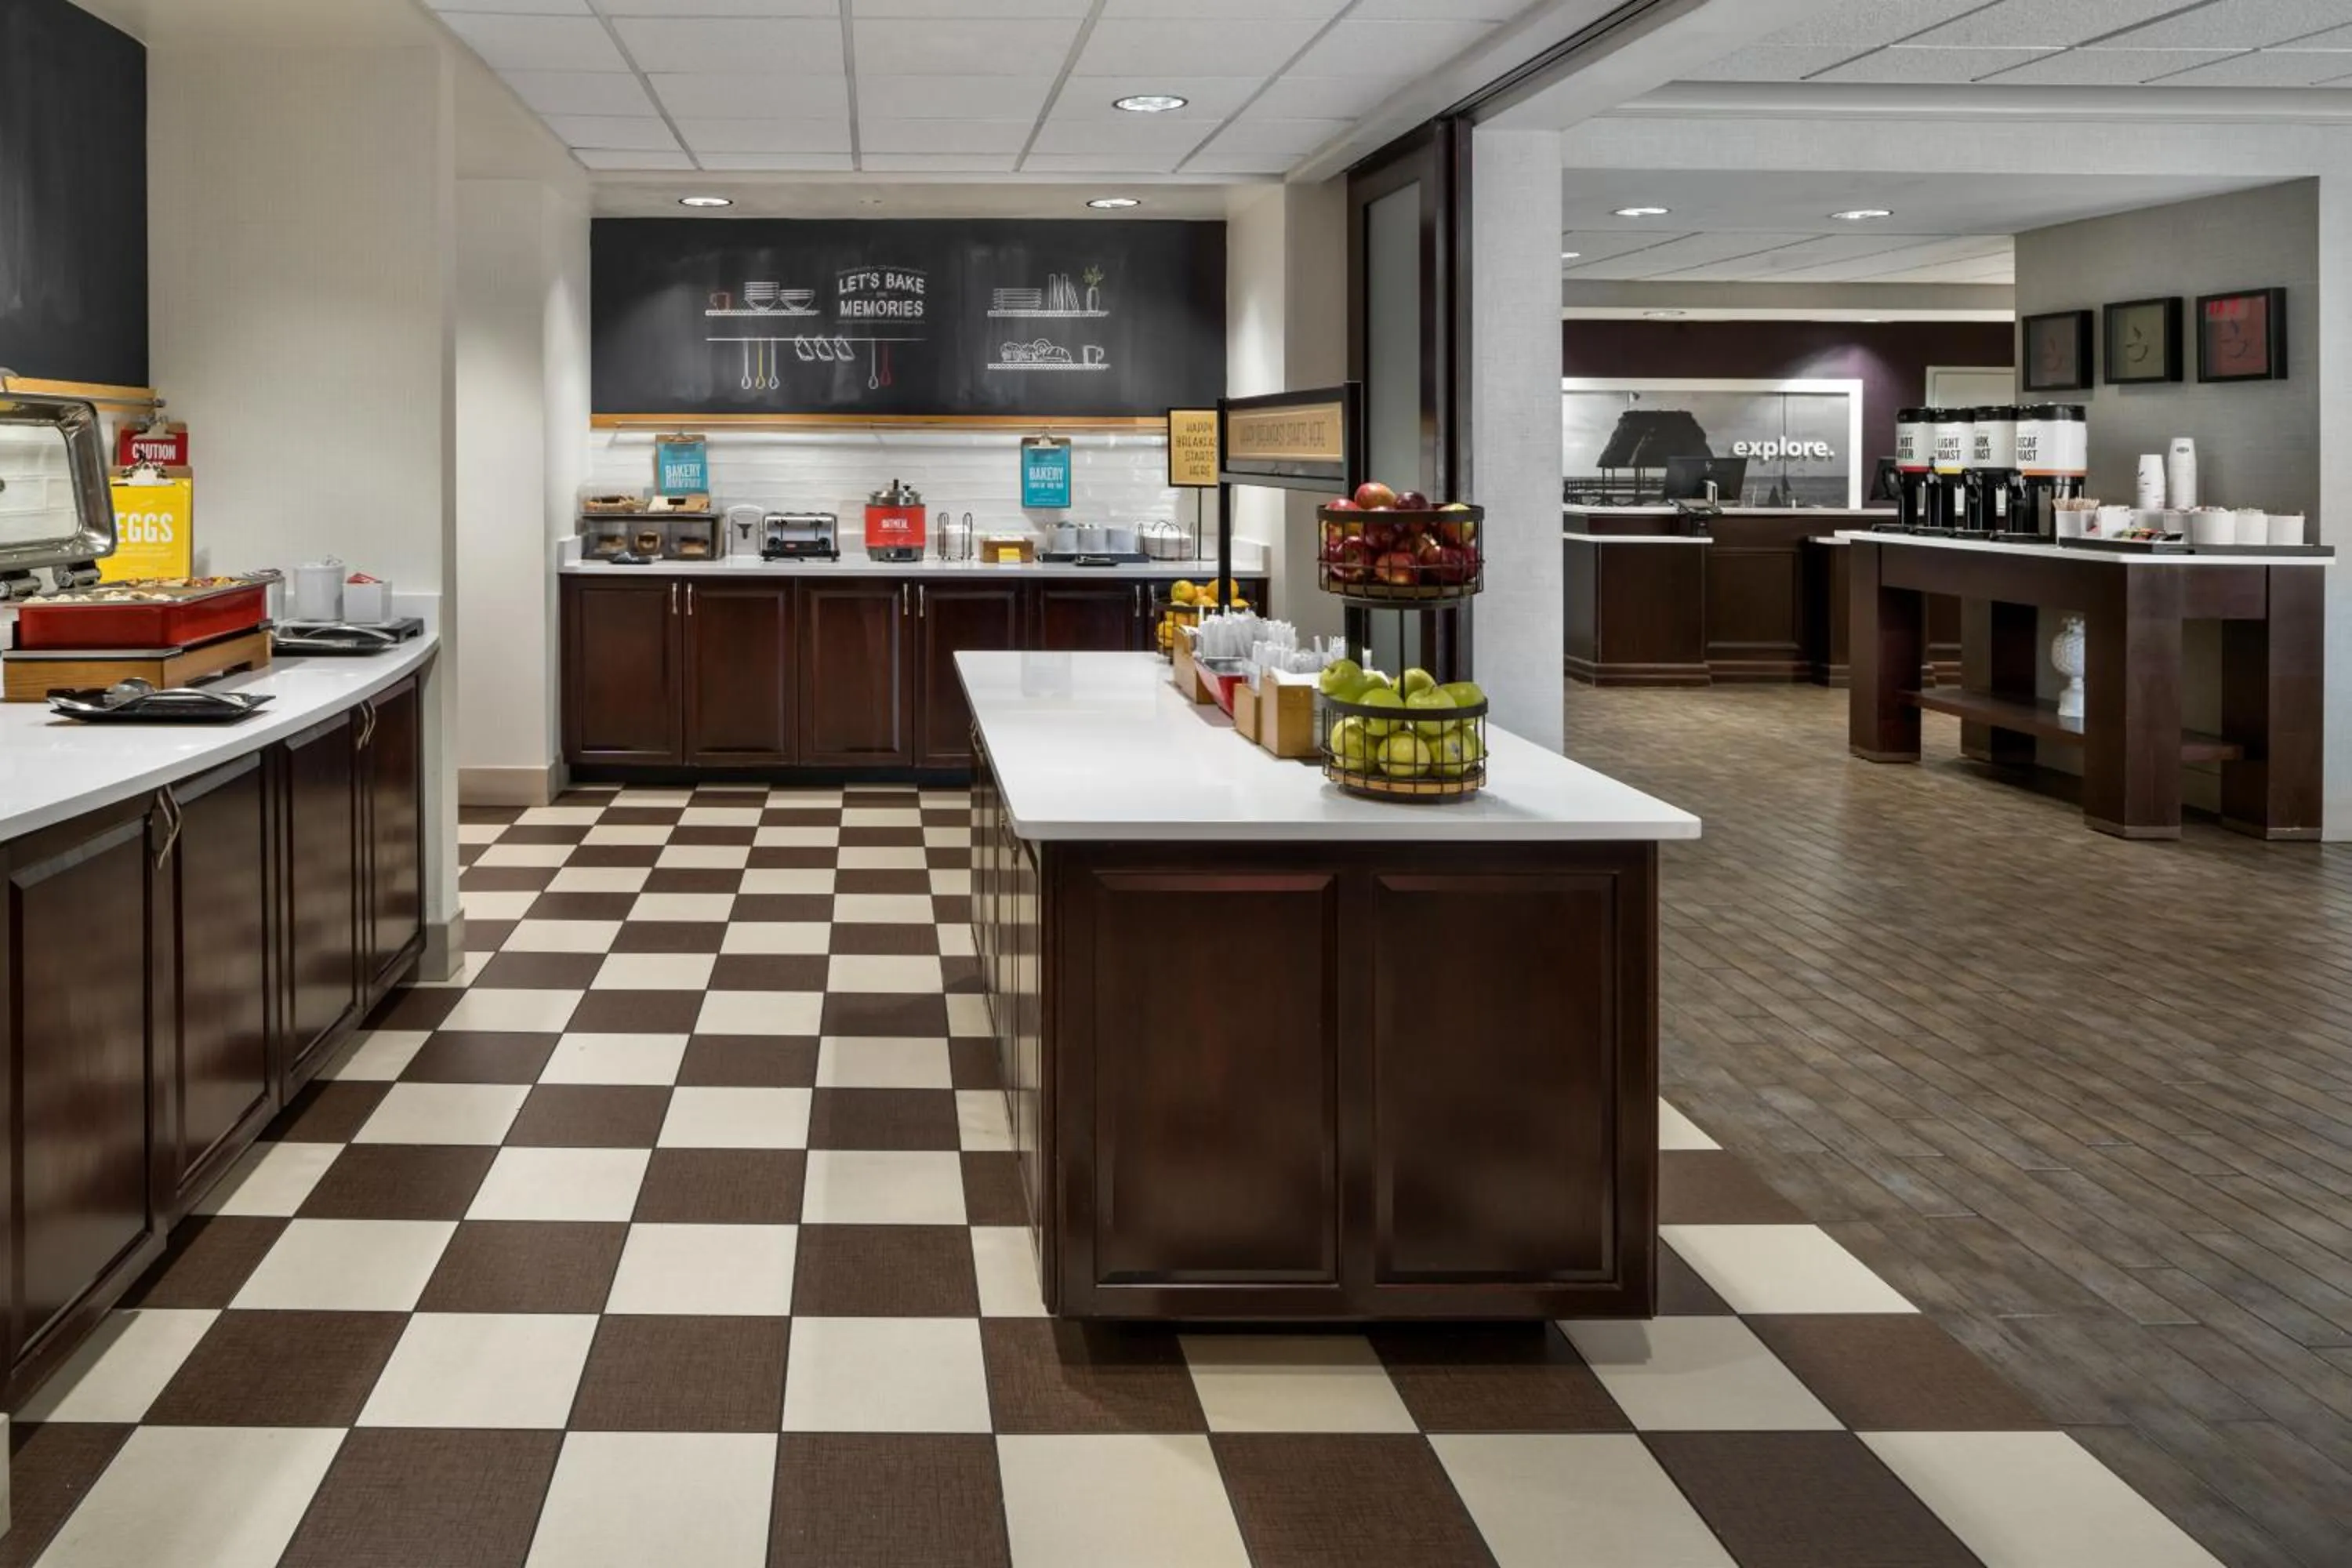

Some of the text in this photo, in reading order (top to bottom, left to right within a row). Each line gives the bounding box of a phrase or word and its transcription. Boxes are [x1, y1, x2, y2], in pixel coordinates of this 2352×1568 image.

[839, 272, 924, 294] LET'S BAKE
[840, 299, 924, 318] MEMORIES
[1733, 435, 1835, 461] explore.
[1937, 437, 1960, 448] LIGHT
[665, 464, 700, 477] BAKERY
[1029, 466, 1064, 481] BAKERY
[115, 512, 174, 543] EGGS
